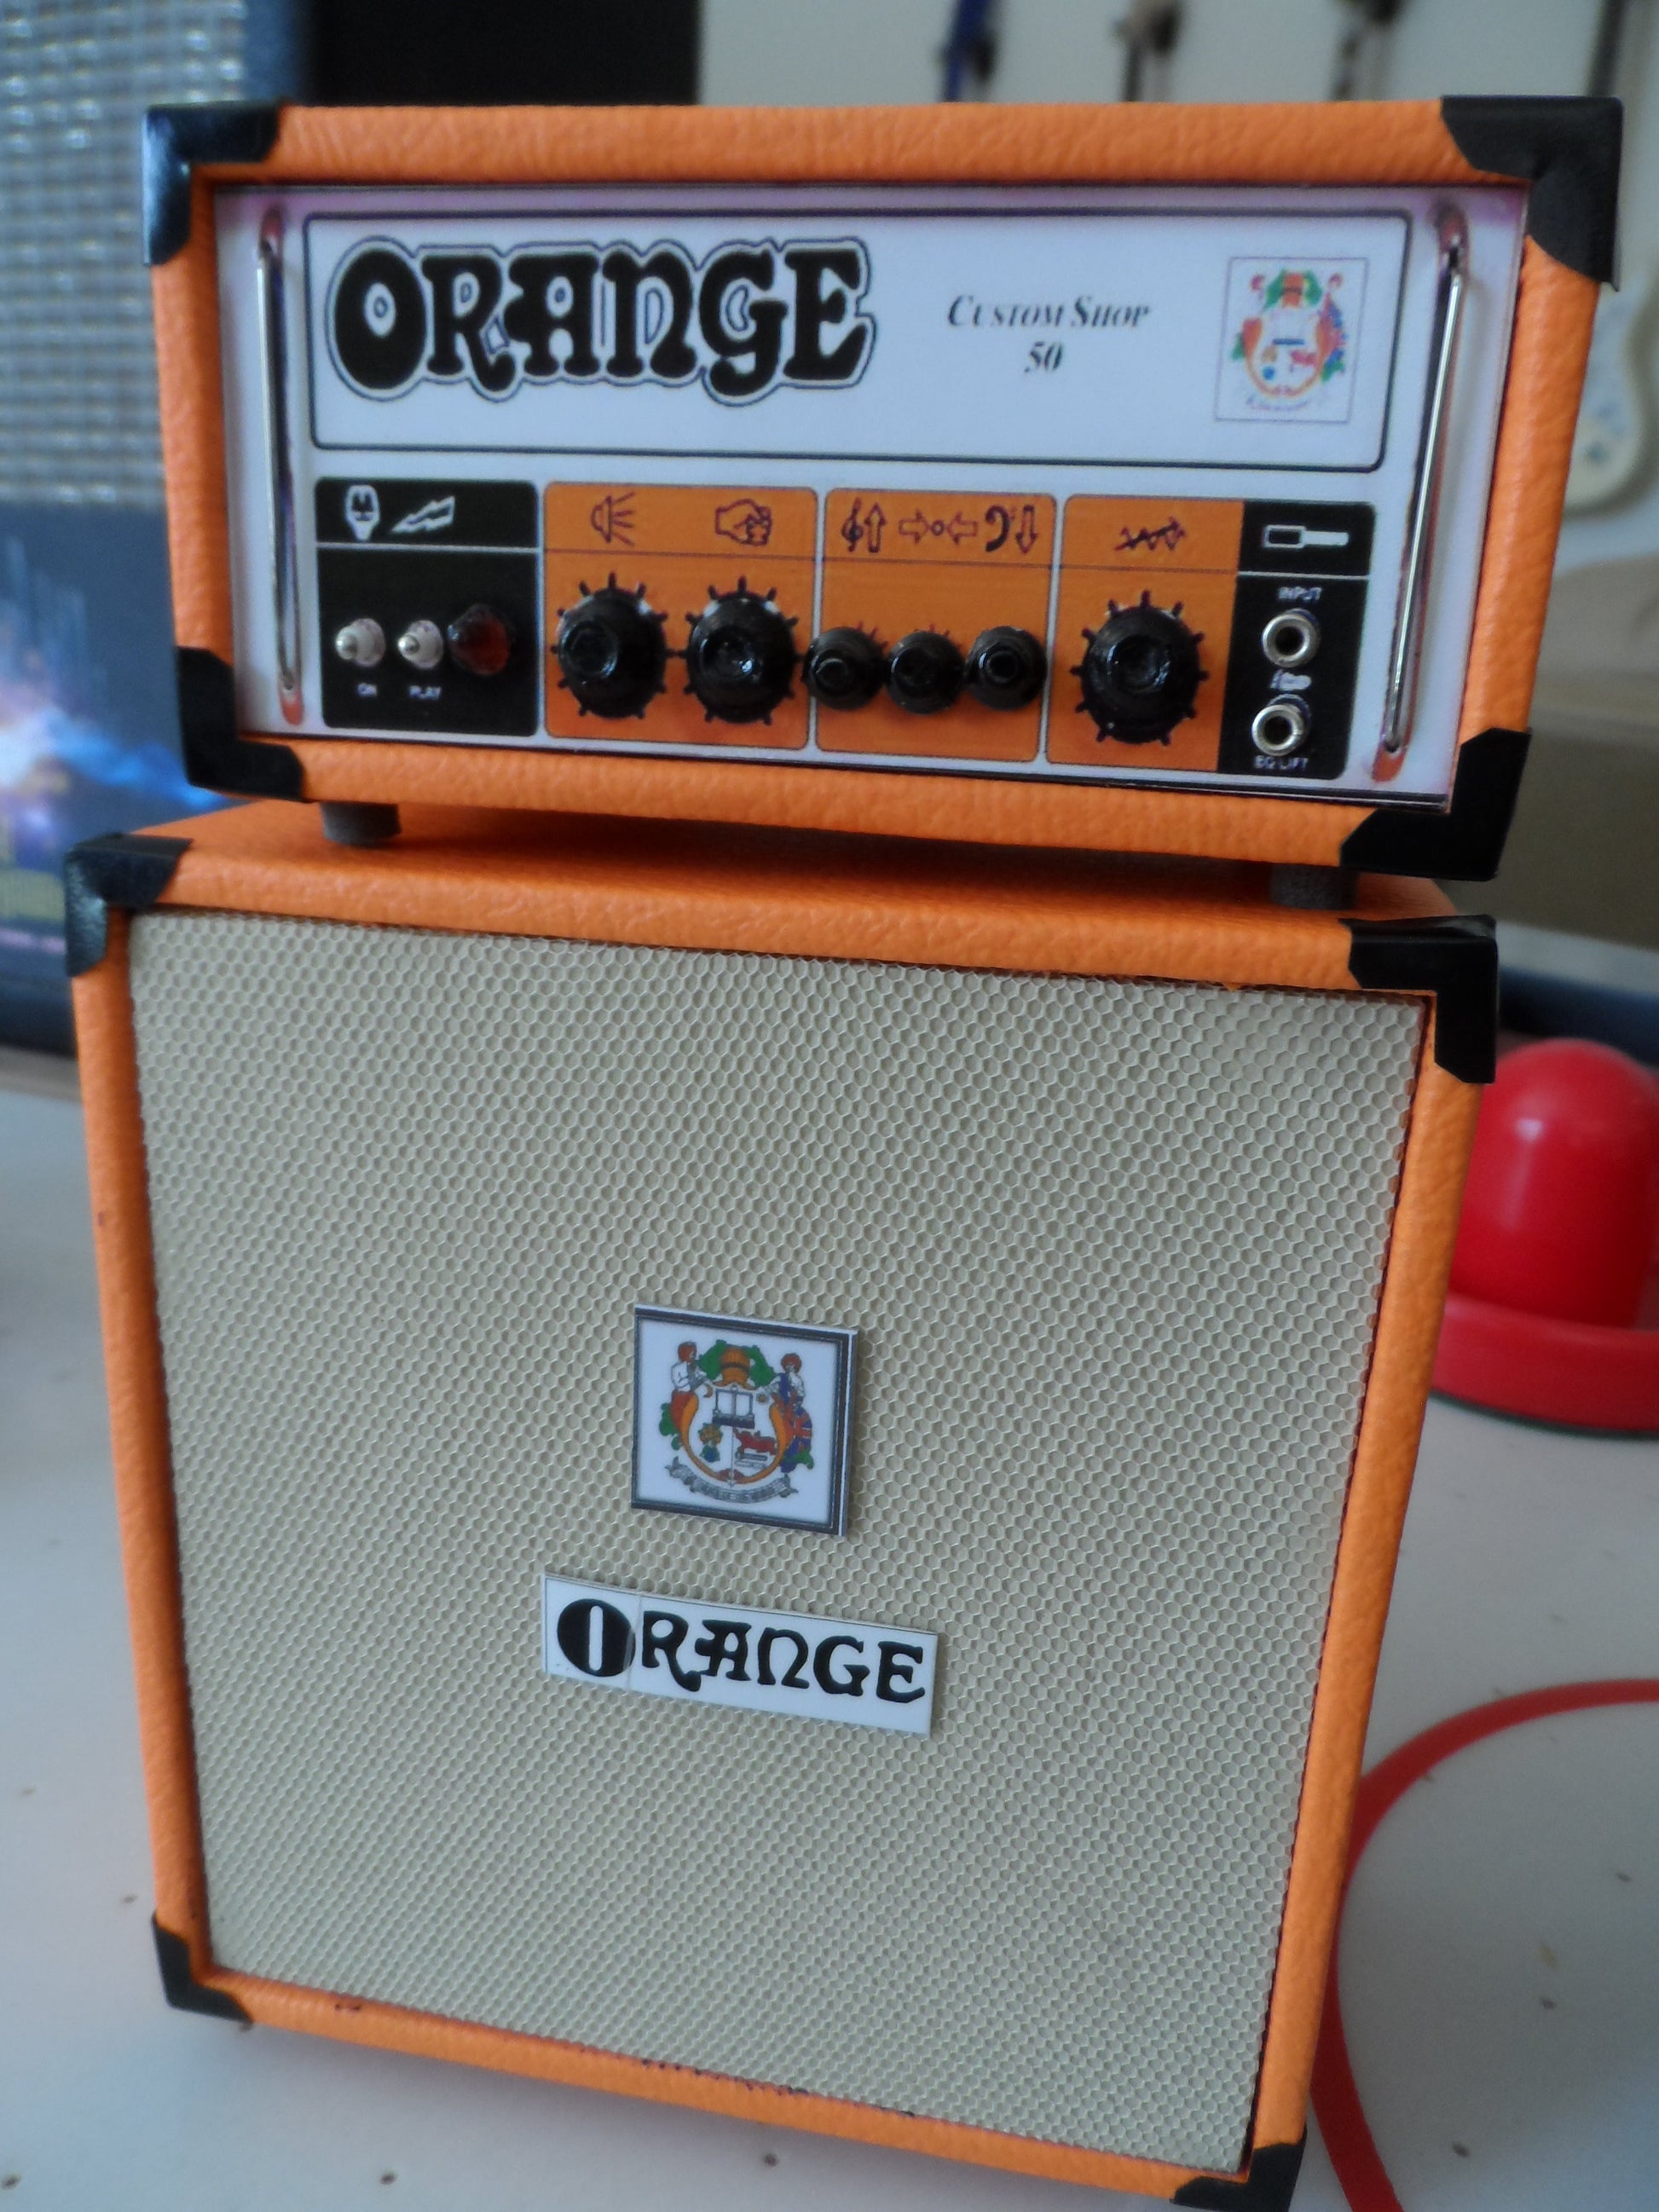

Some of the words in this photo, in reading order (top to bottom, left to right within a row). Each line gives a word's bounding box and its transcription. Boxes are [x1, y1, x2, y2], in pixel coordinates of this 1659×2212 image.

[332, 246, 871, 398] ORANGE
[1024, 340, 1064, 373] 50
[556, 1597, 927, 1705] ORANGE
